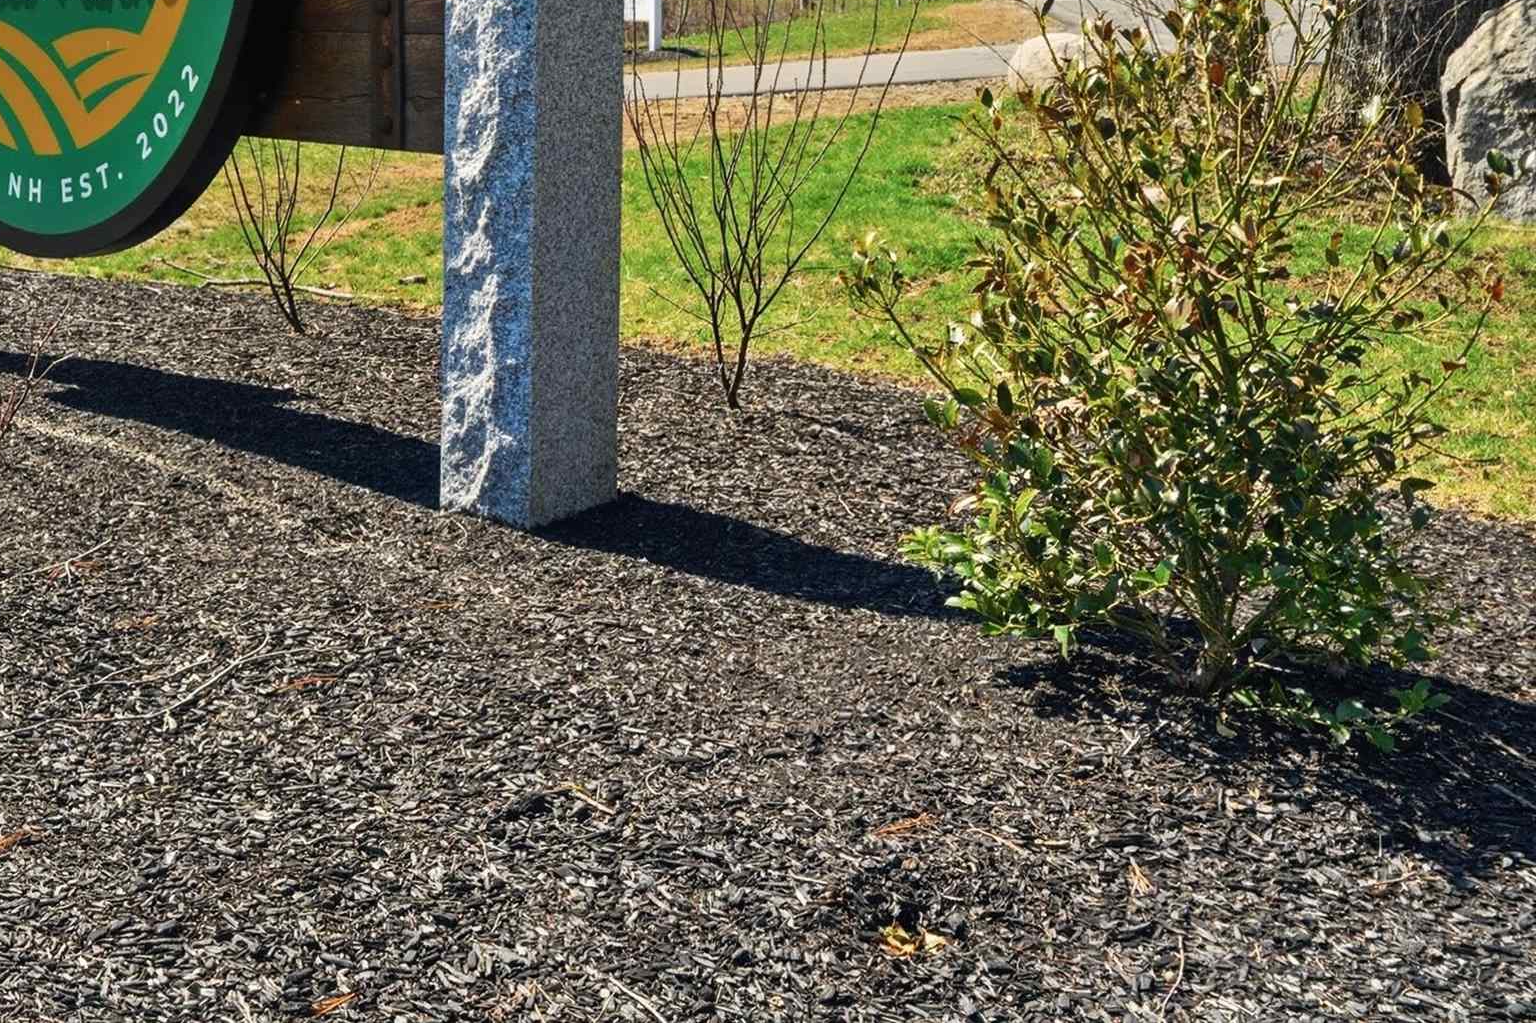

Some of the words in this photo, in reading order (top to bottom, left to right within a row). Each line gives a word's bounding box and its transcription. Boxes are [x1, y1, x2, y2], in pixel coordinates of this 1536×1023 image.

[7, 171, 43, 204] NH
[60, 162, 124, 203] EST.
[135, 64, 200, 161] 2022
